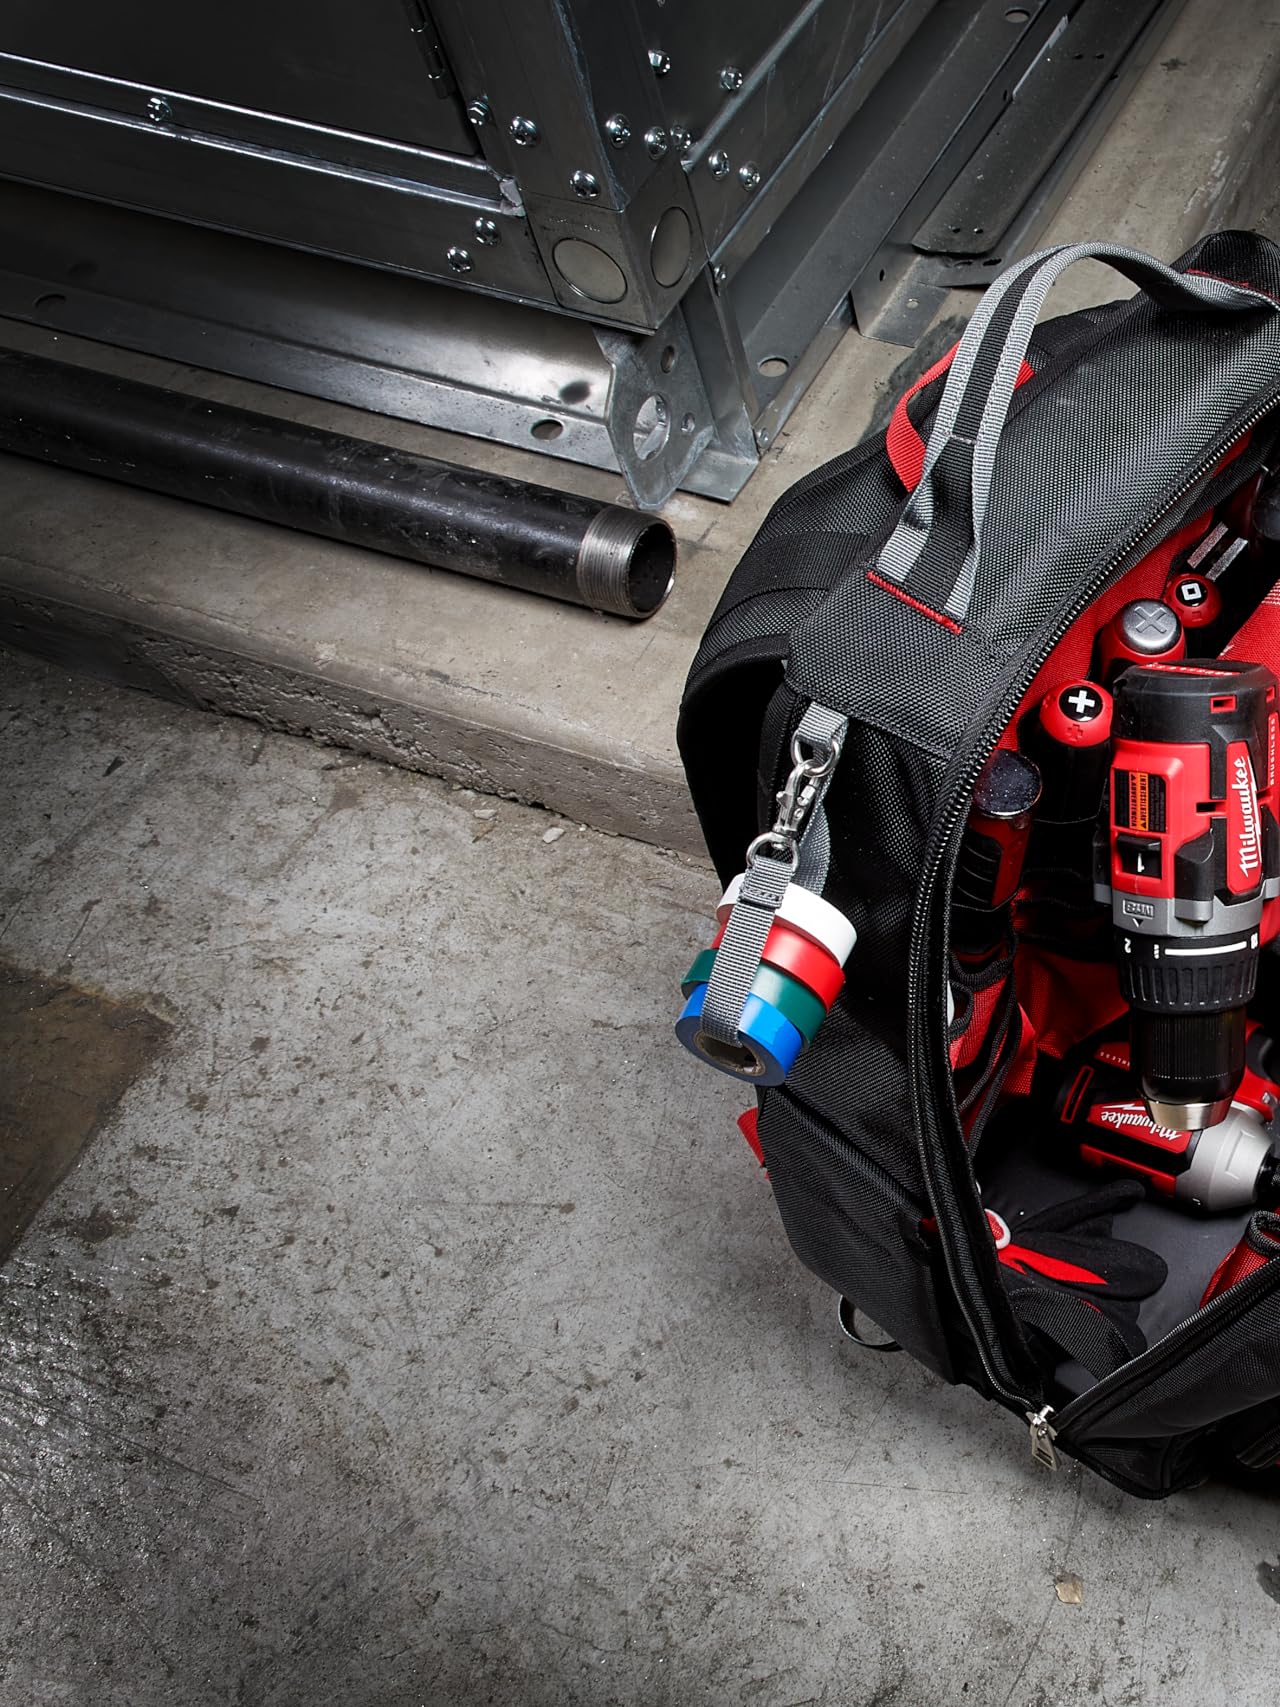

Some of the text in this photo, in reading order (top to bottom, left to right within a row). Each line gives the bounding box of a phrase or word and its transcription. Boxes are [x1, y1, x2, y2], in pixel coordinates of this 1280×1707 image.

[1232, 756, 1259, 878] Milwaukee
[1137, 853, 1145, 873] 1
[1124, 938, 1132, 954] 2
